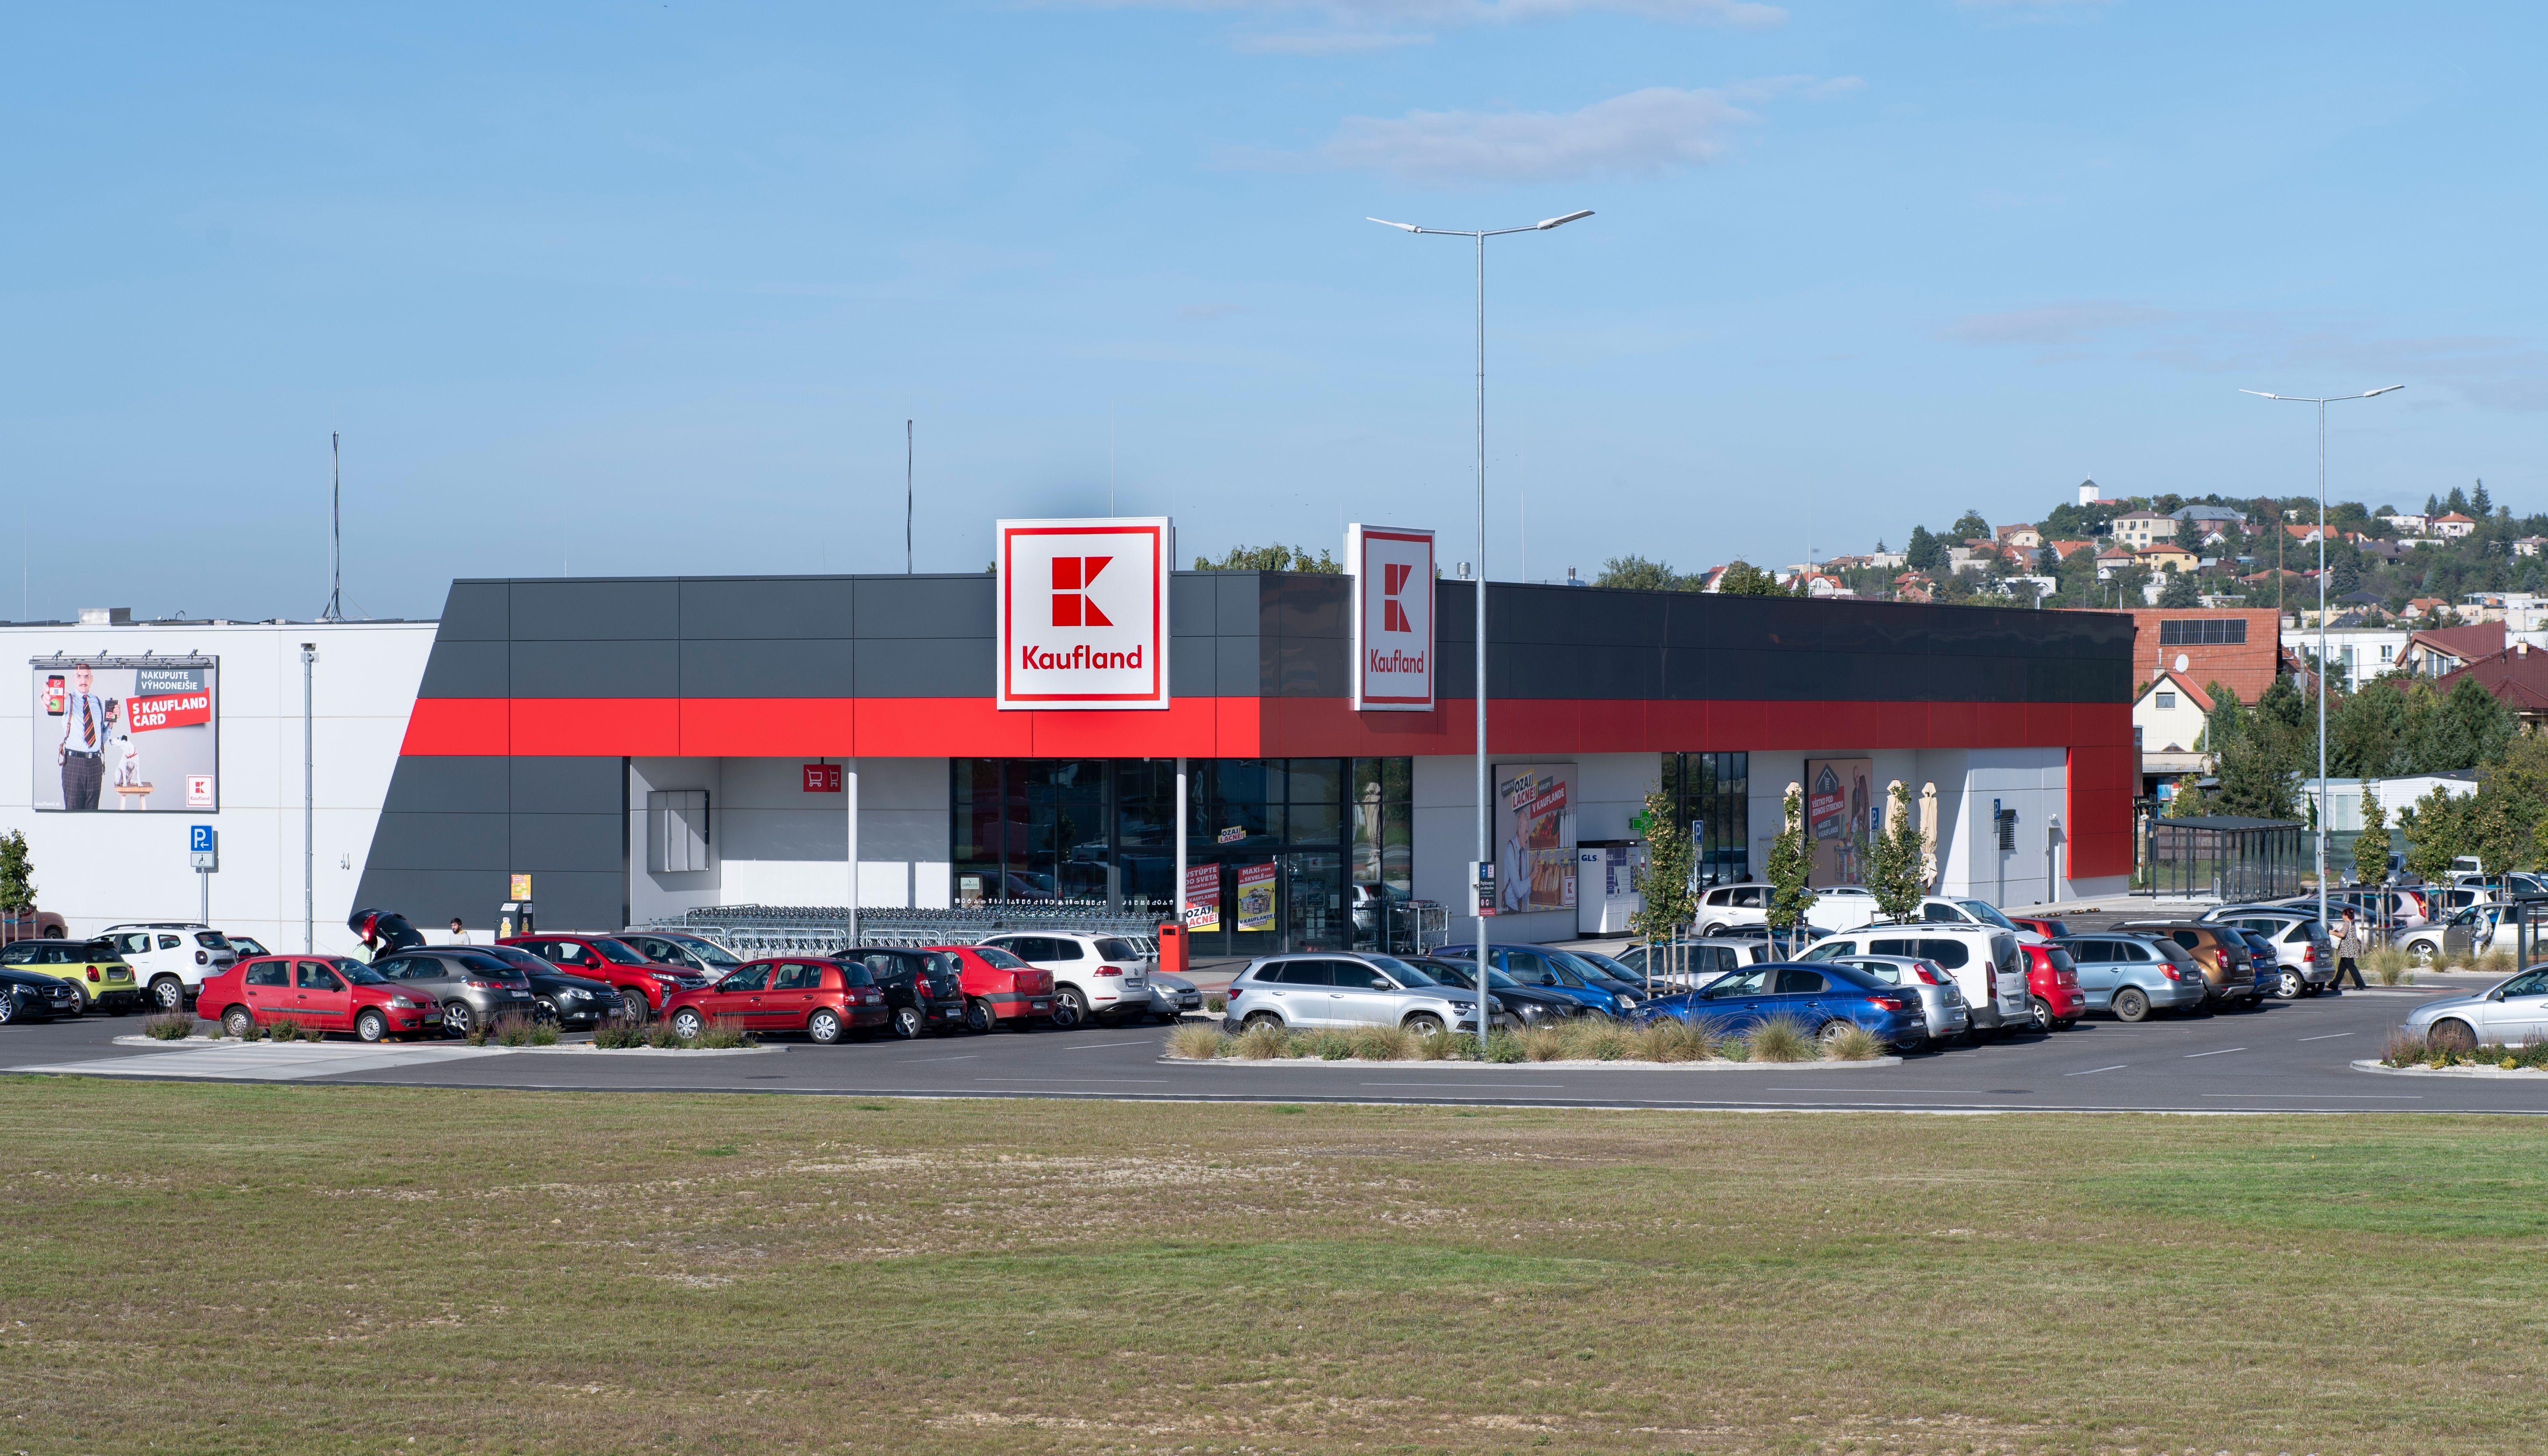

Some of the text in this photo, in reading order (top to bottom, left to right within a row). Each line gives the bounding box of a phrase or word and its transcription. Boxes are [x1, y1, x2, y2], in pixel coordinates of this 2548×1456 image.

[1022, 645, 1142, 670] Kaufland
[1370, 648, 1424, 674] Kaufland
[141, 671, 188, 679] NAKUPUJTE
[141, 680, 198, 690] VÝHODNEJŠIE
[132, 697, 208, 714] S KAUFLAND
[133, 713, 166, 727] CARD
[1502, 782, 1514, 791] OBJAVTE
[1515, 774, 1531, 793] OZAJ
[1539, 782, 1550, 791] NÁKUPY
[1513, 784, 1535, 808] LACNÉ!
[1532, 788, 1564, 812] V KAUFLANDE
[1812, 798, 1825, 808] VŠETKO
[1812, 800, 1844, 816] JEDNOU STRECHOU
[1872, 810, 1876, 827] P
[1222, 828, 1238, 836] OZAJ
[1696, 824, 1701, 842] P
[1821, 826, 1839, 837] KAUFLANDE
[194, 828, 206, 848] P
[1220, 833, 1243, 843] LACNÉ!
[1186, 867, 1217, 878] VSTÚPTE
[1242, 867, 1260, 875] MAXI
[1196, 874, 1217, 883] SVETA
[1245, 873, 1264, 882] SKVELÉ
[1189, 893, 1217, 902] KAUFLANDE
[1186, 906, 1211, 918] OZAJ
[1189, 913, 1217, 926] ACNÉ!
[1244, 914, 1273, 923] KAUFLANDE
